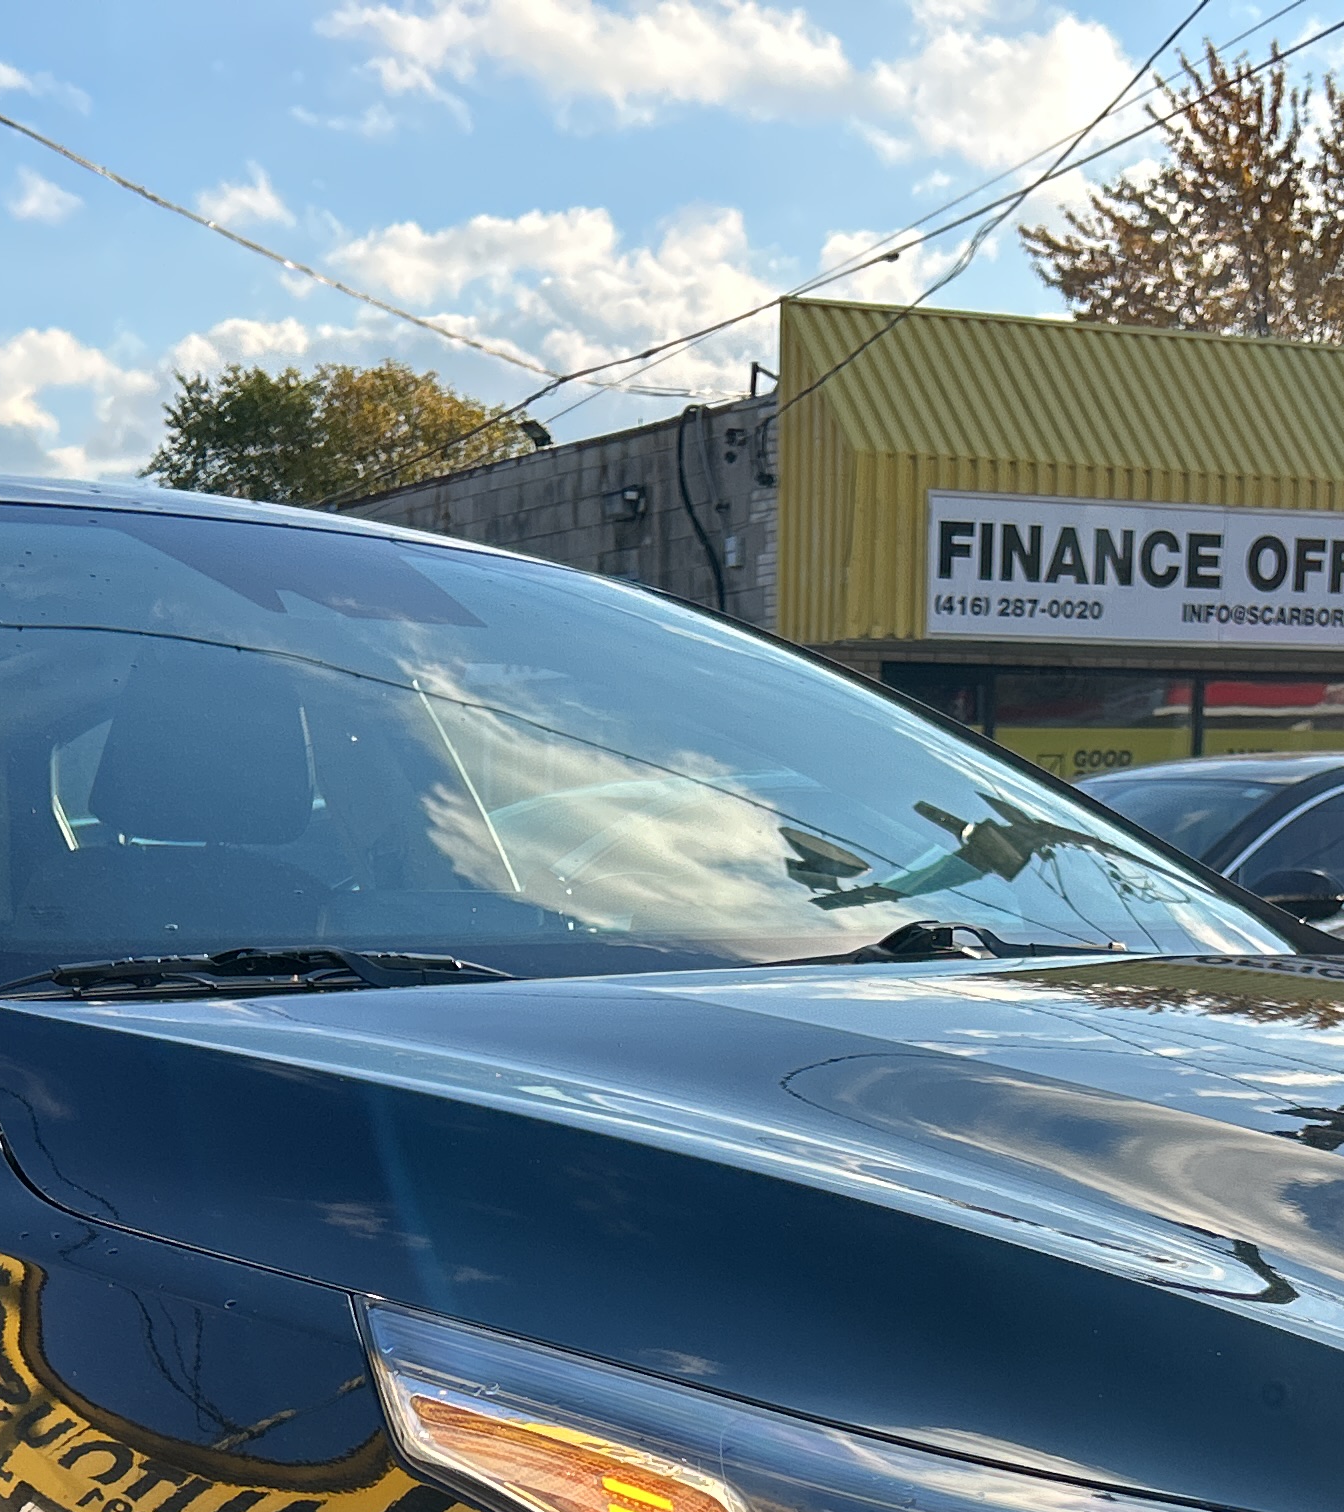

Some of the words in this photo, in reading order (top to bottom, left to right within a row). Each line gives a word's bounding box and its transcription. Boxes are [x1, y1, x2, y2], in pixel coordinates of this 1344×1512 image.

[937, 520, 1222, 589] FINANCE
[934, 594, 990, 618] (416)
[997, 598, 1104, 621] 287-0020
[1072, 749, 1133, 768] GOOD
